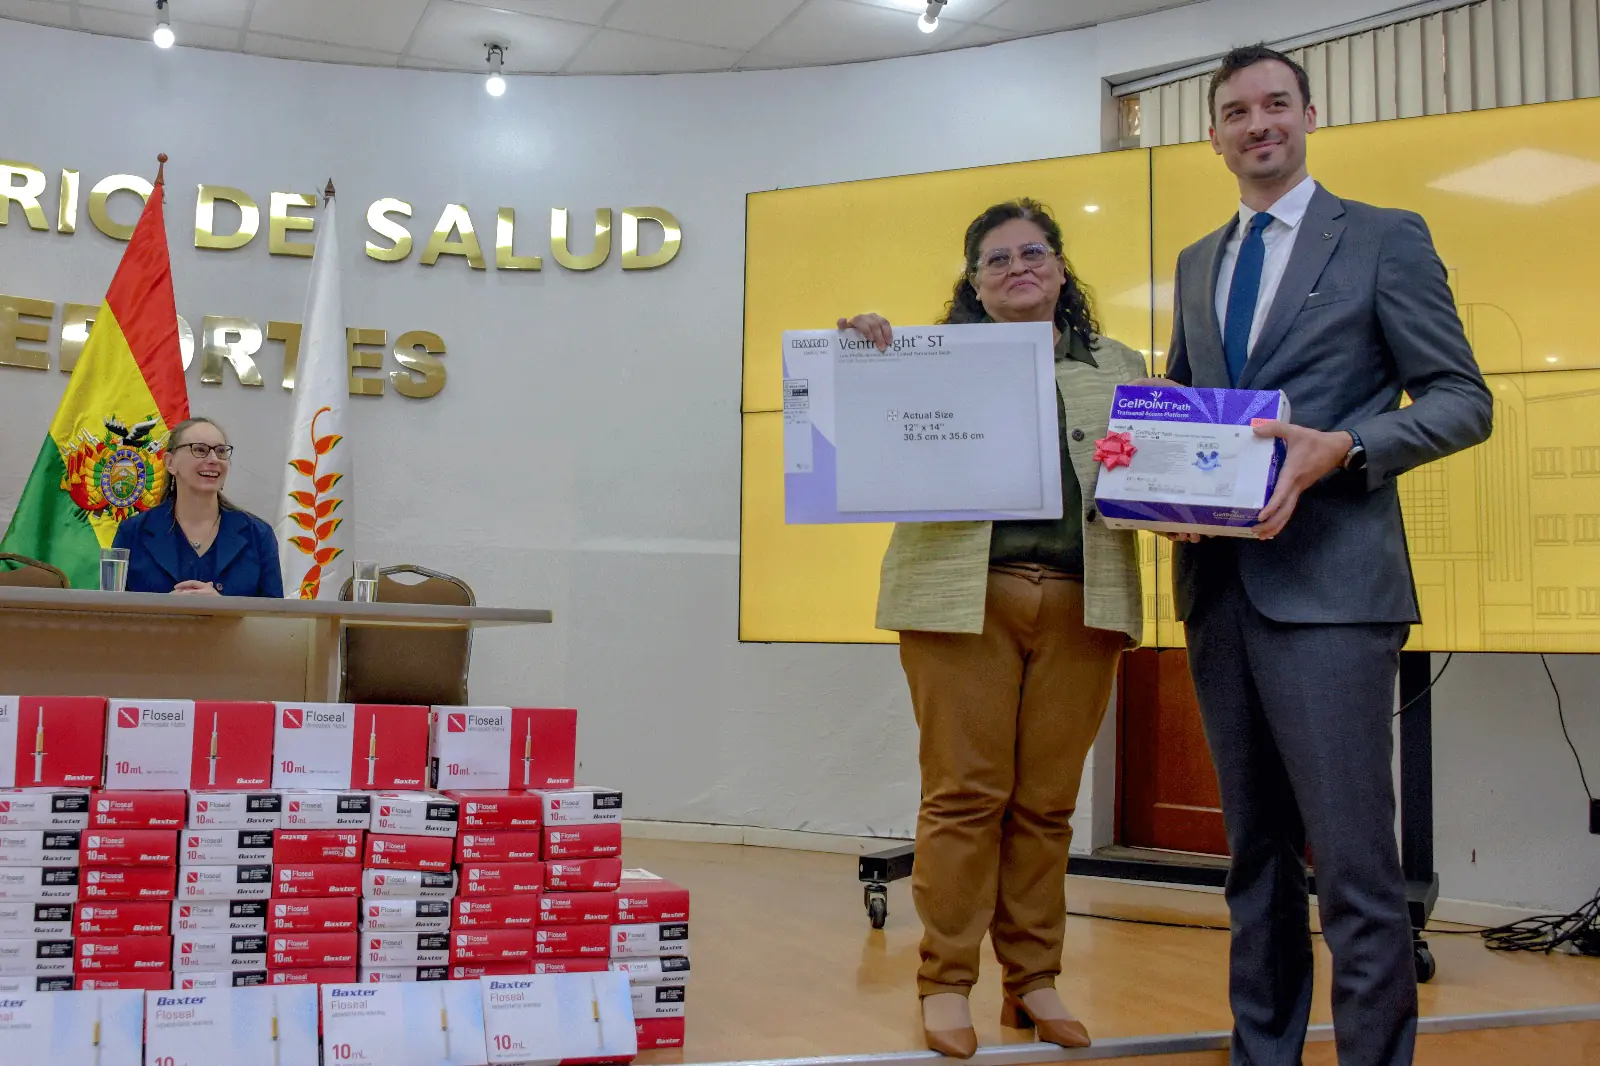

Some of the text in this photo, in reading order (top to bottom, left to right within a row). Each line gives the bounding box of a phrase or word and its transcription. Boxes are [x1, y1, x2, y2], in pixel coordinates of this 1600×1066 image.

[194, 184, 317, 259] DE
[365, 197, 682, 271] SALUD
[928, 336, 944, 347] ST
[0, 295, 447, 399] EPRTES
[1172, 403, 1190, 411] Path
[949, 432, 967, 440] 35.6
[142, 710, 184, 720] Floseal
[306, 711, 344, 722] Floseal
[468, 715, 503, 726] Floseal
[490, 981, 533, 989] Baxter
[157, 997, 207, 1005] Baxter
[490, 992, 524, 1001] Floseal
[331, 1000, 367, 1009] Floseal
[156, 1009, 194, 1020] Floseal
